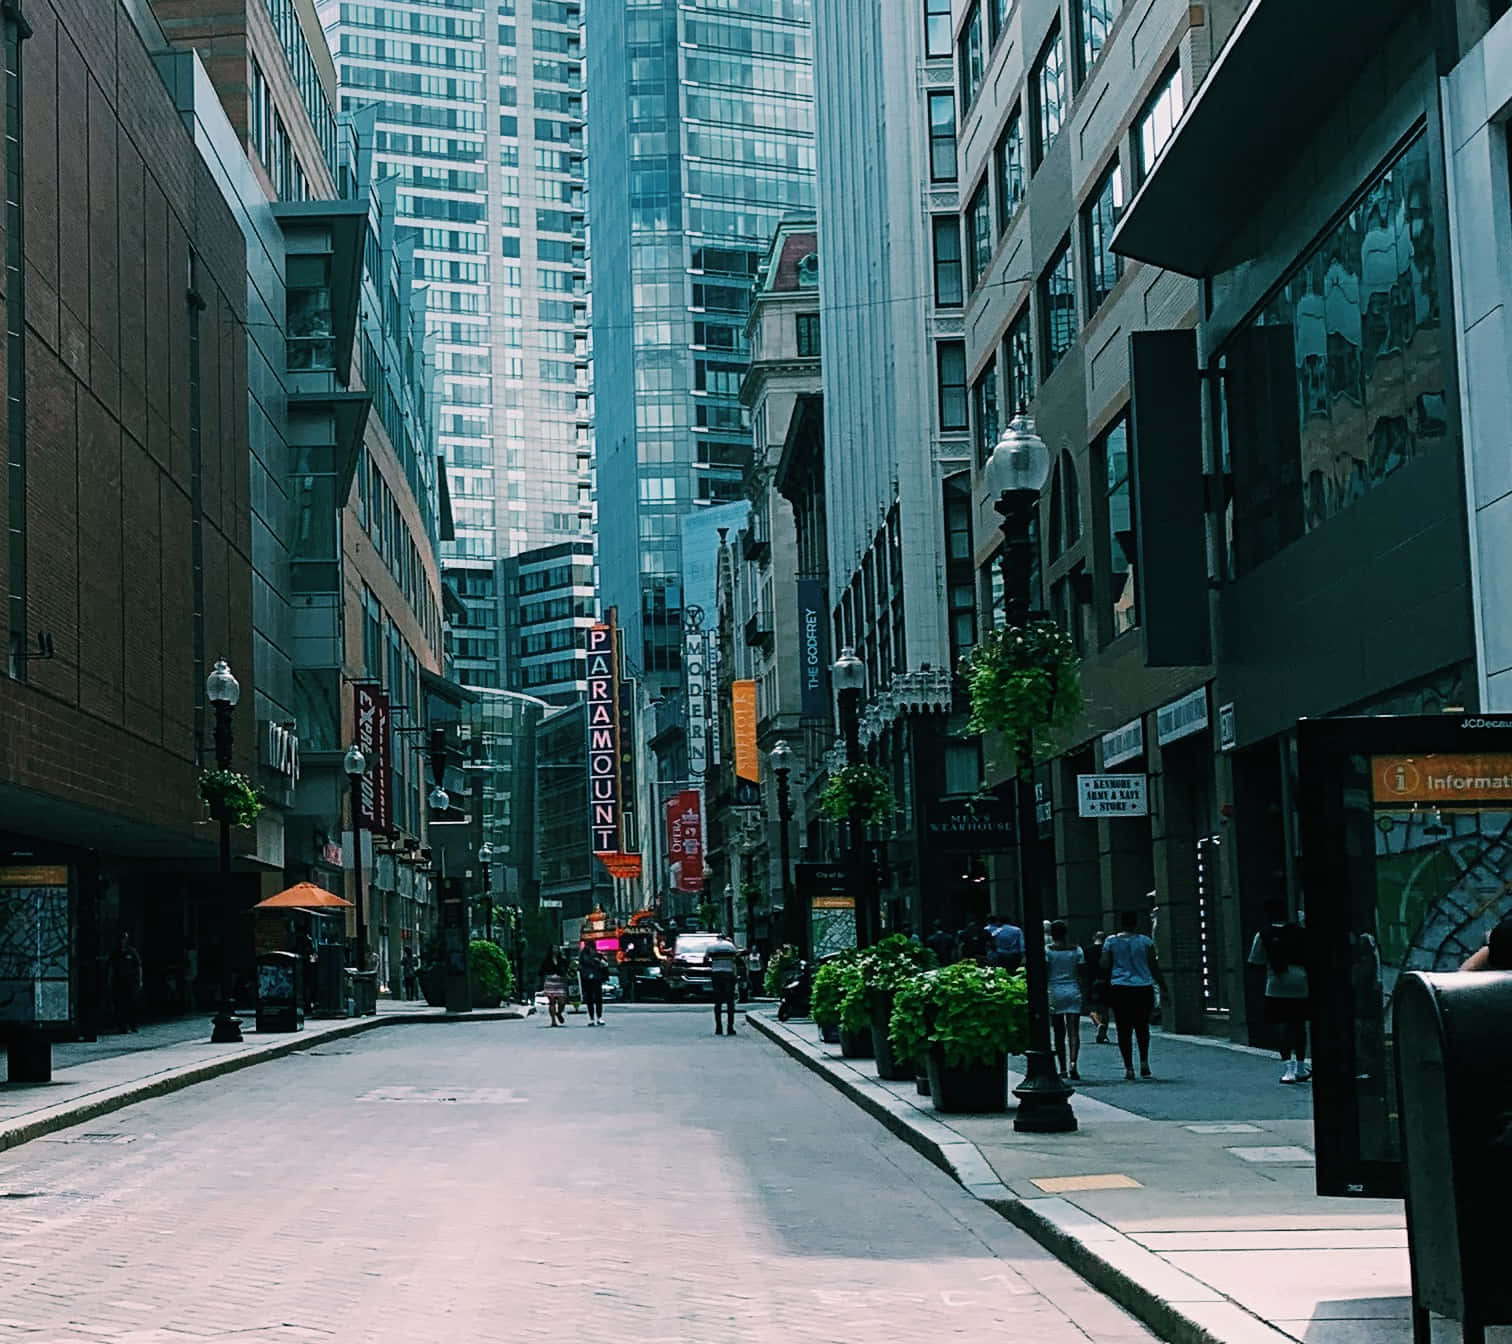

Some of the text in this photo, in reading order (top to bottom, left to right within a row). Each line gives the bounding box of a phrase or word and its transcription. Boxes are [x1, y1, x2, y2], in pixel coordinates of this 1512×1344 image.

[806, 608, 819, 690] THE GODFREY
[688, 641, 705, 760] MODERN
[359, 690, 375, 822] EXPREIONS
[590, 631, 613, 850] PARAMOUNT
[1087, 791, 1108, 801] ARMY
[1119, 790, 1139, 800] NAVY
[1094, 779, 1131, 789] KENMORE
[1099, 802, 1126, 812] STORE
[929, 823, 1013, 832] WEARHOUSE
